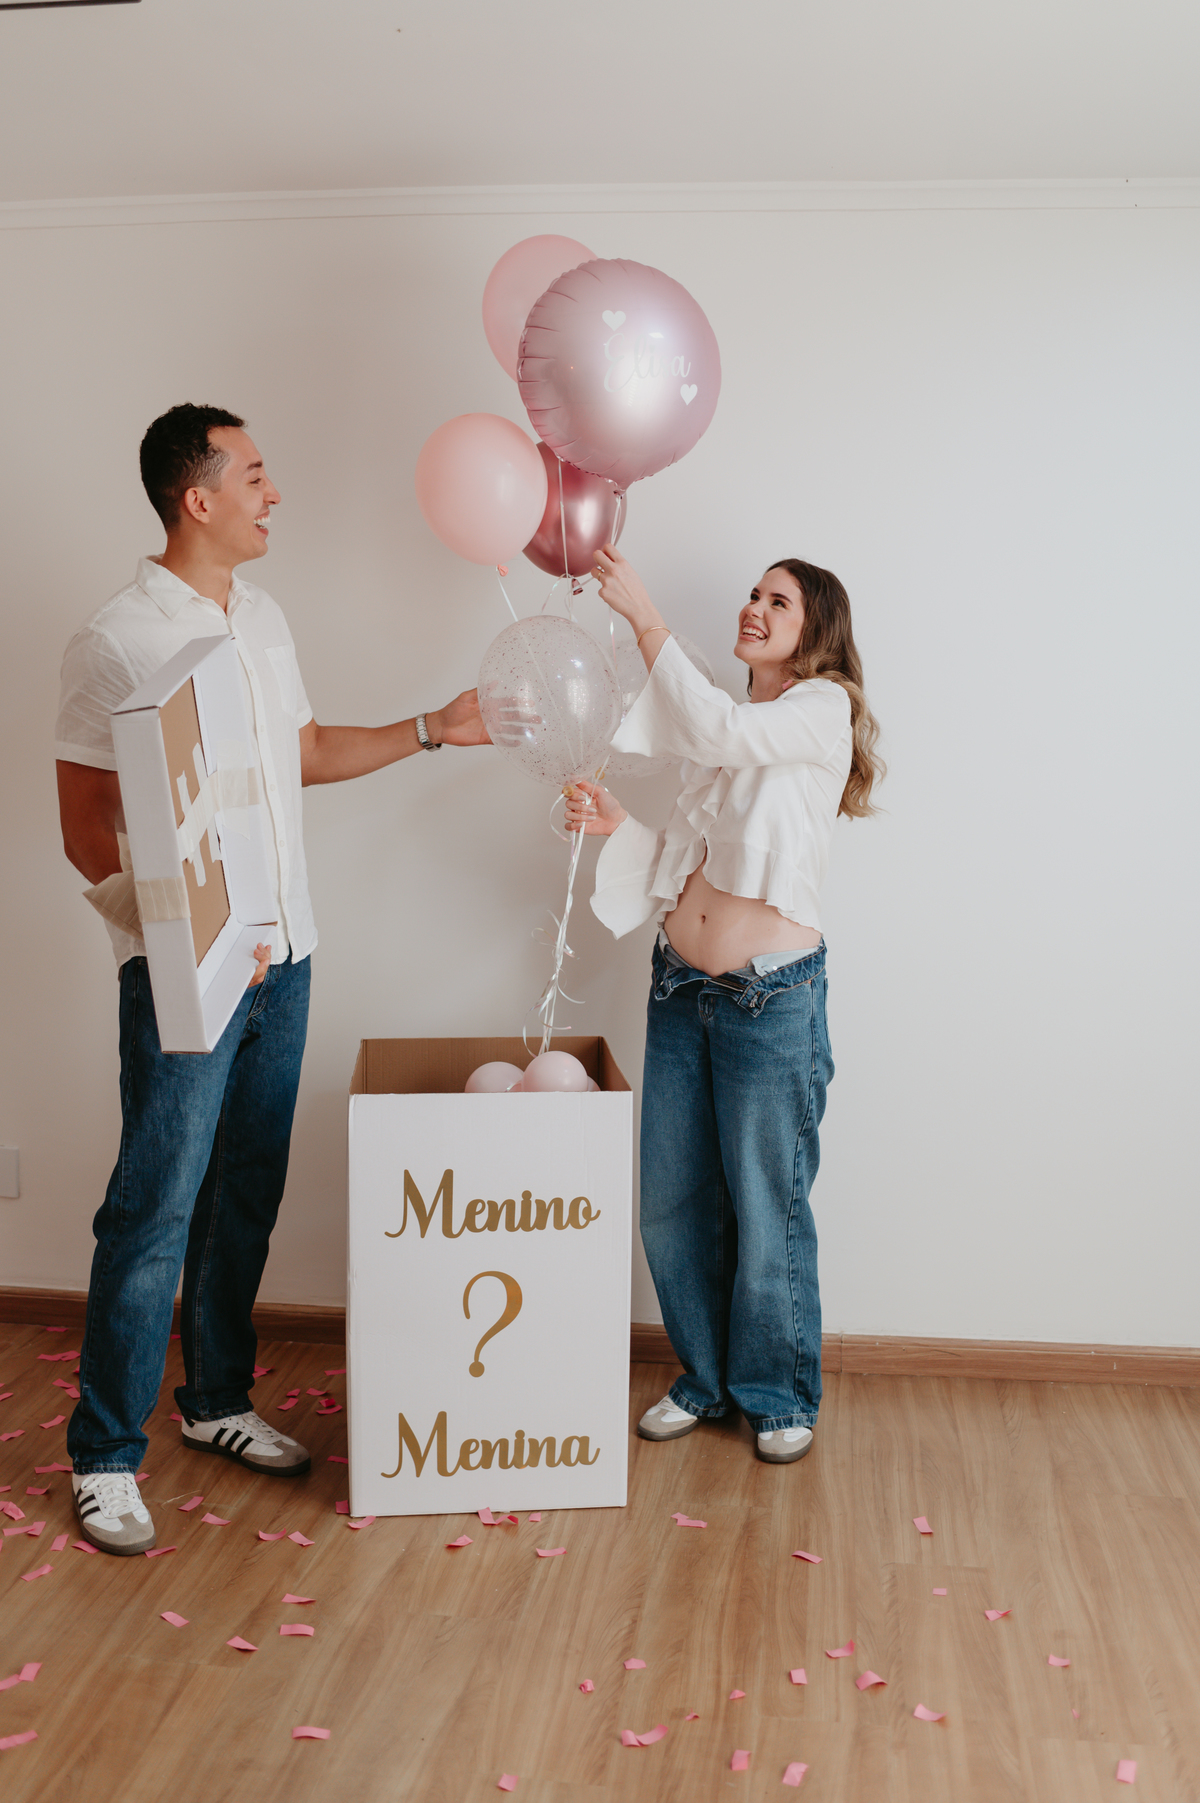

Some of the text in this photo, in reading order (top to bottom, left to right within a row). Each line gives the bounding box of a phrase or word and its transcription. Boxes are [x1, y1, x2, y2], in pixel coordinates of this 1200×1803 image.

[603, 332, 692, 393] Elisa
[384, 1168, 601, 1239] Menino
[462, 1270, 523, 1378] ?
[380, 1410, 601, 1479] Menina
